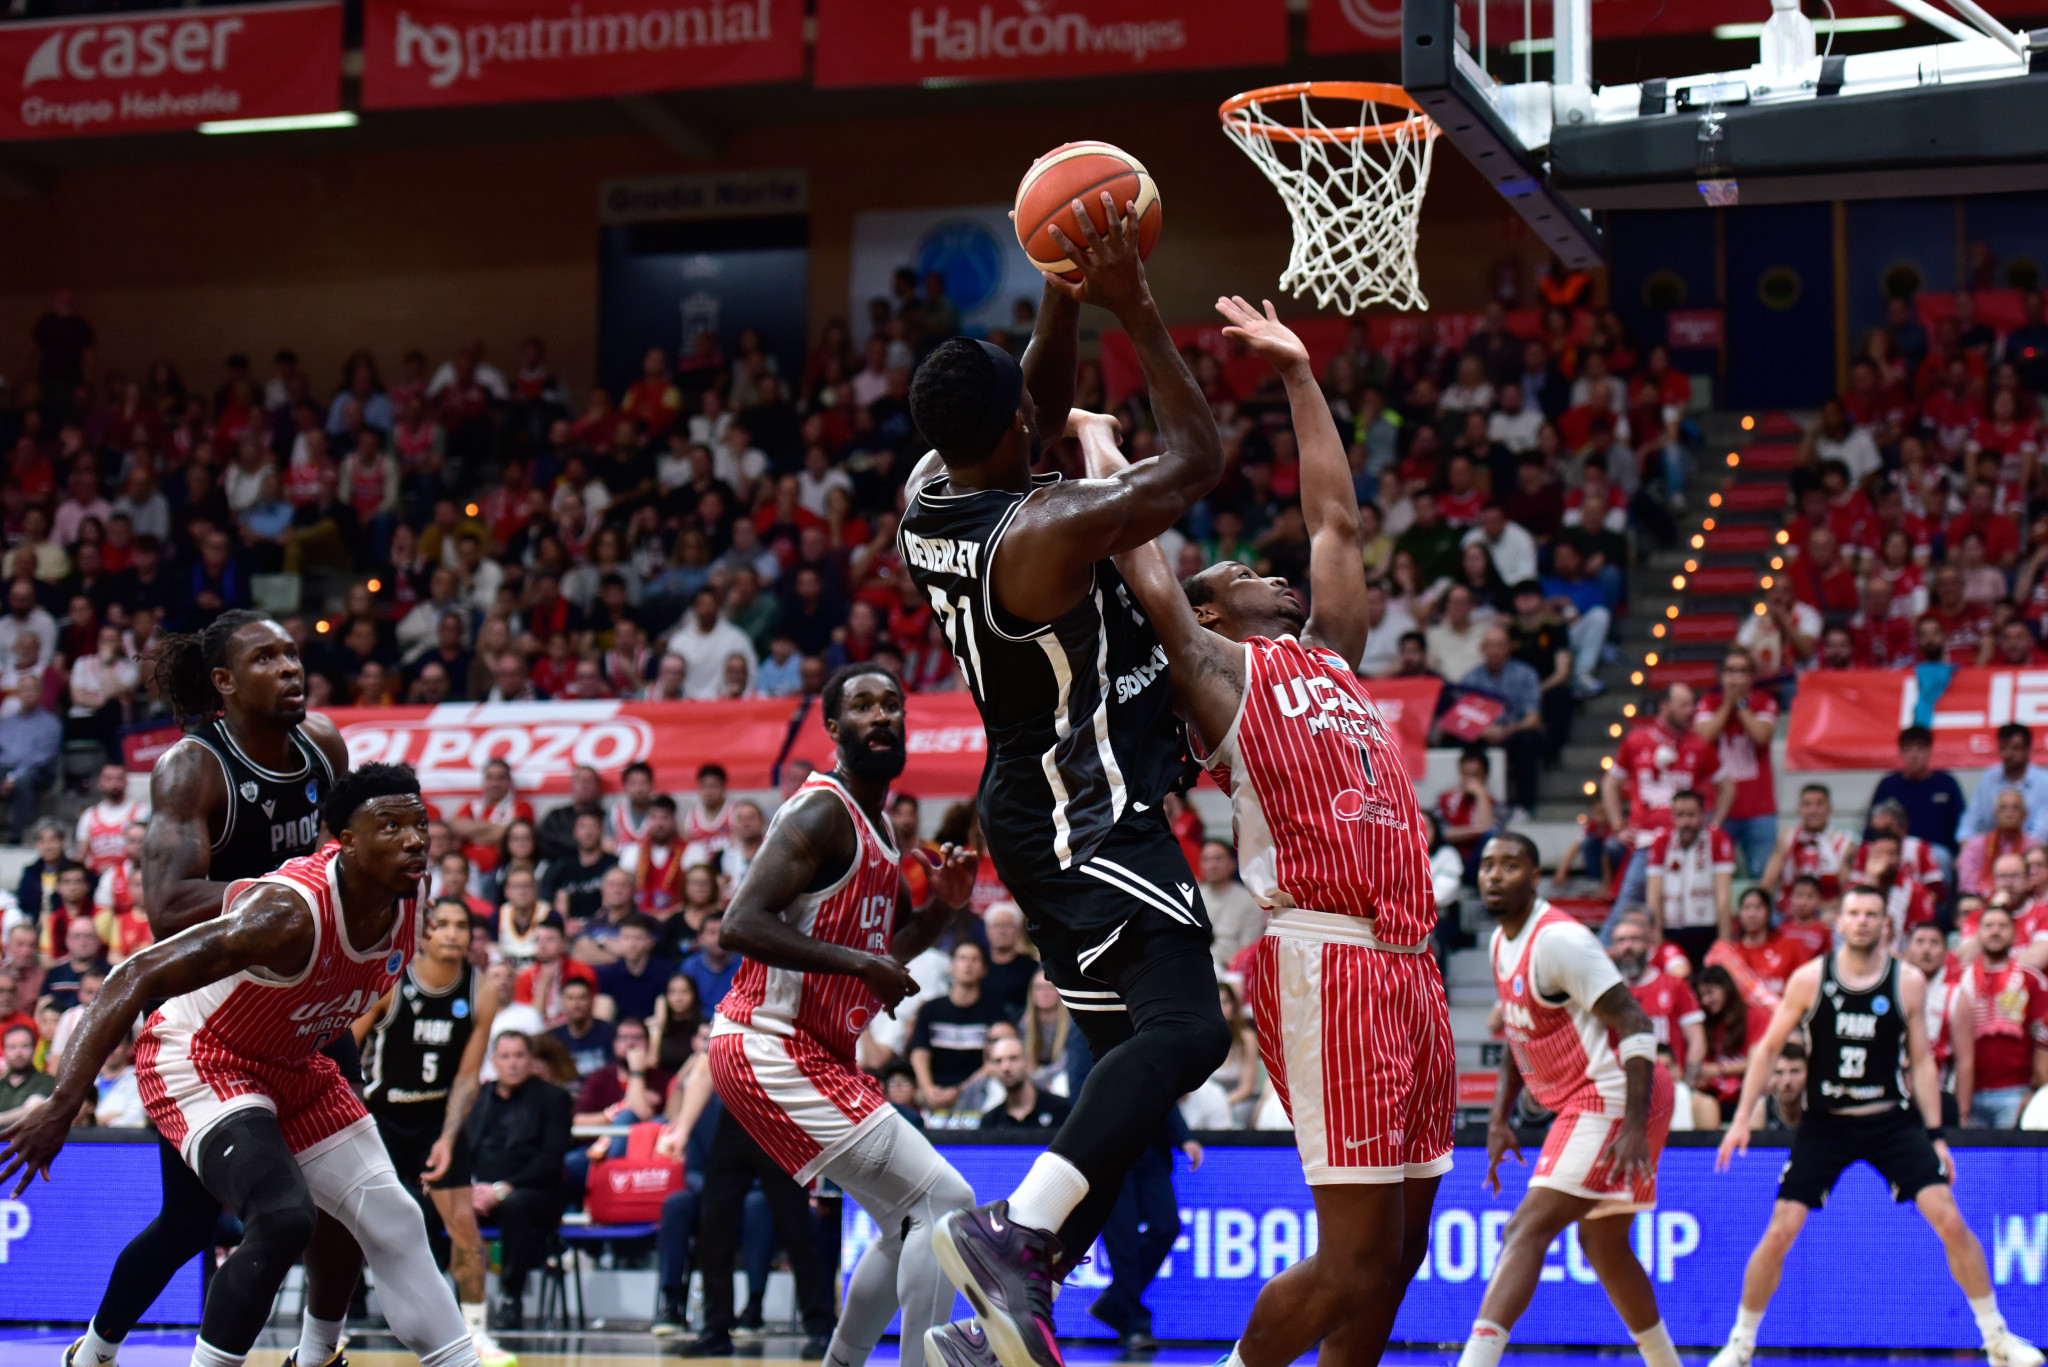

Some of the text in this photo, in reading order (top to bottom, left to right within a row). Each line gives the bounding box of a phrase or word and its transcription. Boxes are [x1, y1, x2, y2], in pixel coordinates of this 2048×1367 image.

[66, 19, 244, 80] caser
[21, 85, 241, 129] Grupo Helvetia
[904, 529, 981, 579] BEVERLEY
[1272, 675, 1391, 733] UCAM
[1376, 816, 1409, 831] MURCIA
[295, 1016, 352, 1038] MURCI
[413, 1018, 454, 1042] PAOK
[1836, 1012, 1878, 1038] PAOK
[422, 1051, 439, 1083] 5
[1839, 1045, 1867, 1078] 33
